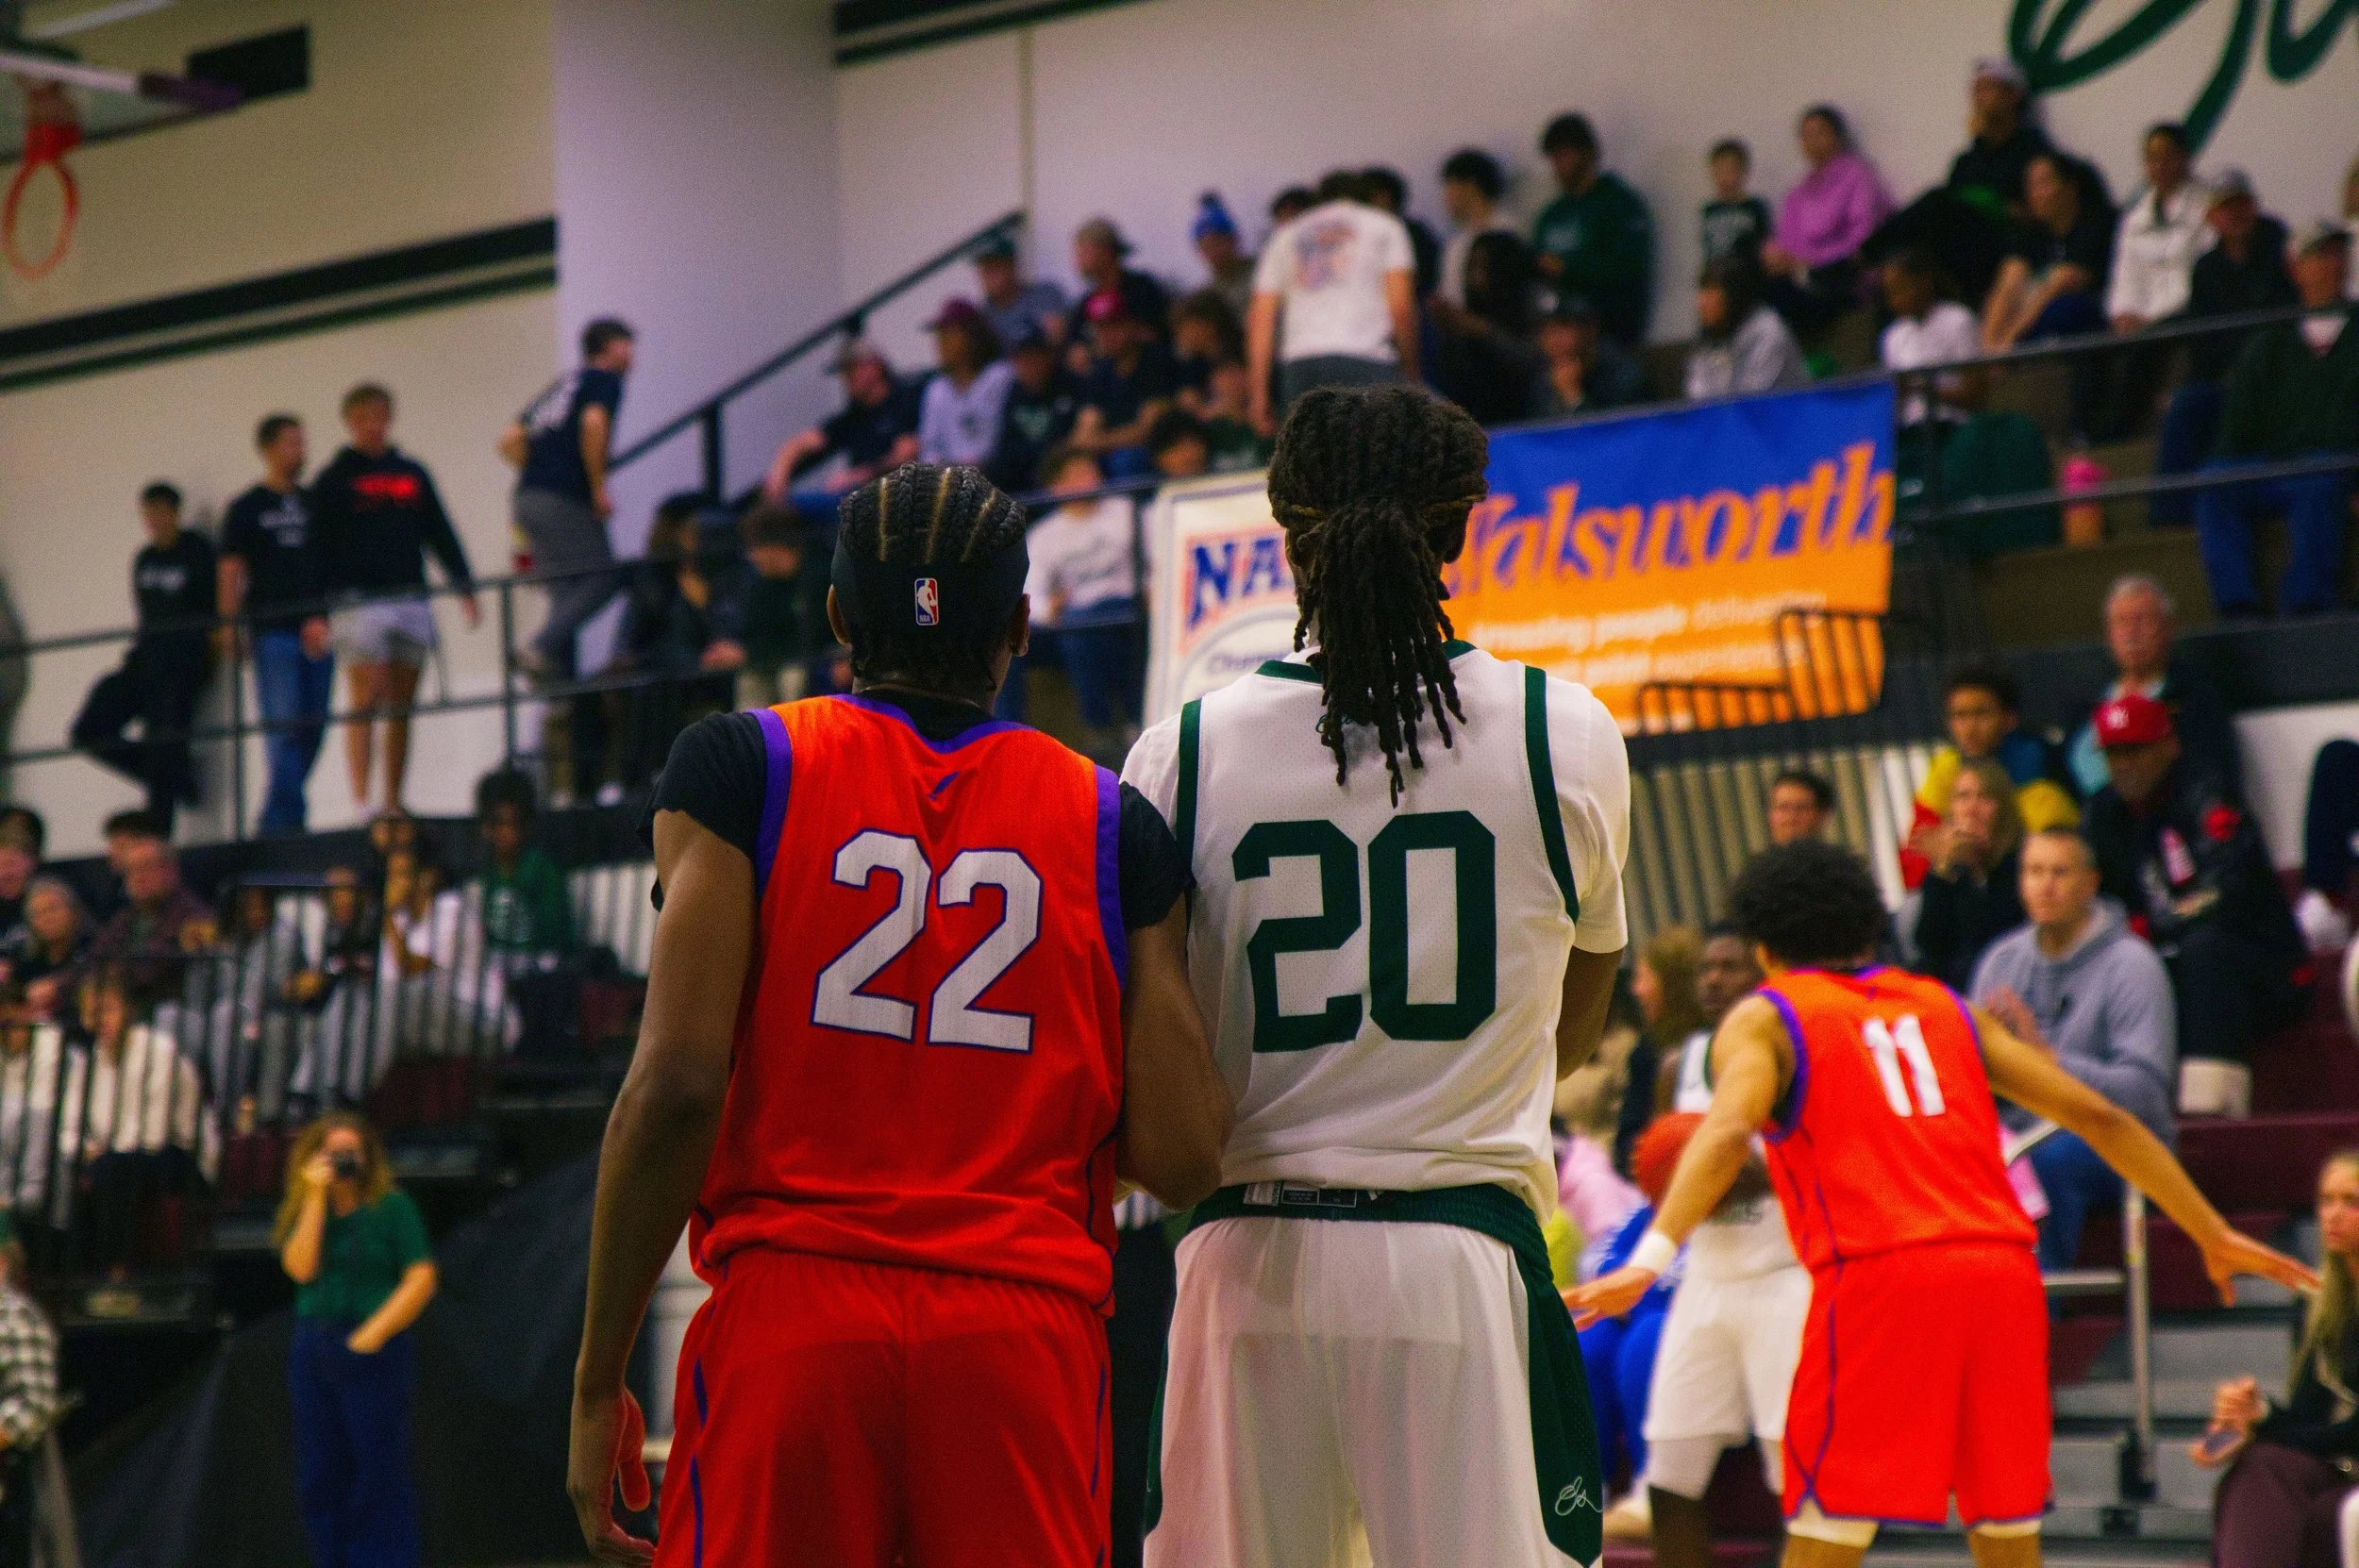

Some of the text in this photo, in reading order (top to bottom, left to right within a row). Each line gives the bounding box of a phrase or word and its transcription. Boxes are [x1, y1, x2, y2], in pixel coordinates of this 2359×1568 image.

[1186, 536, 1296, 630] NA
[811, 828, 1041, 1053] 22
[1231, 809, 1497, 1053] 20
[1863, 1012, 1946, 1117] 11
